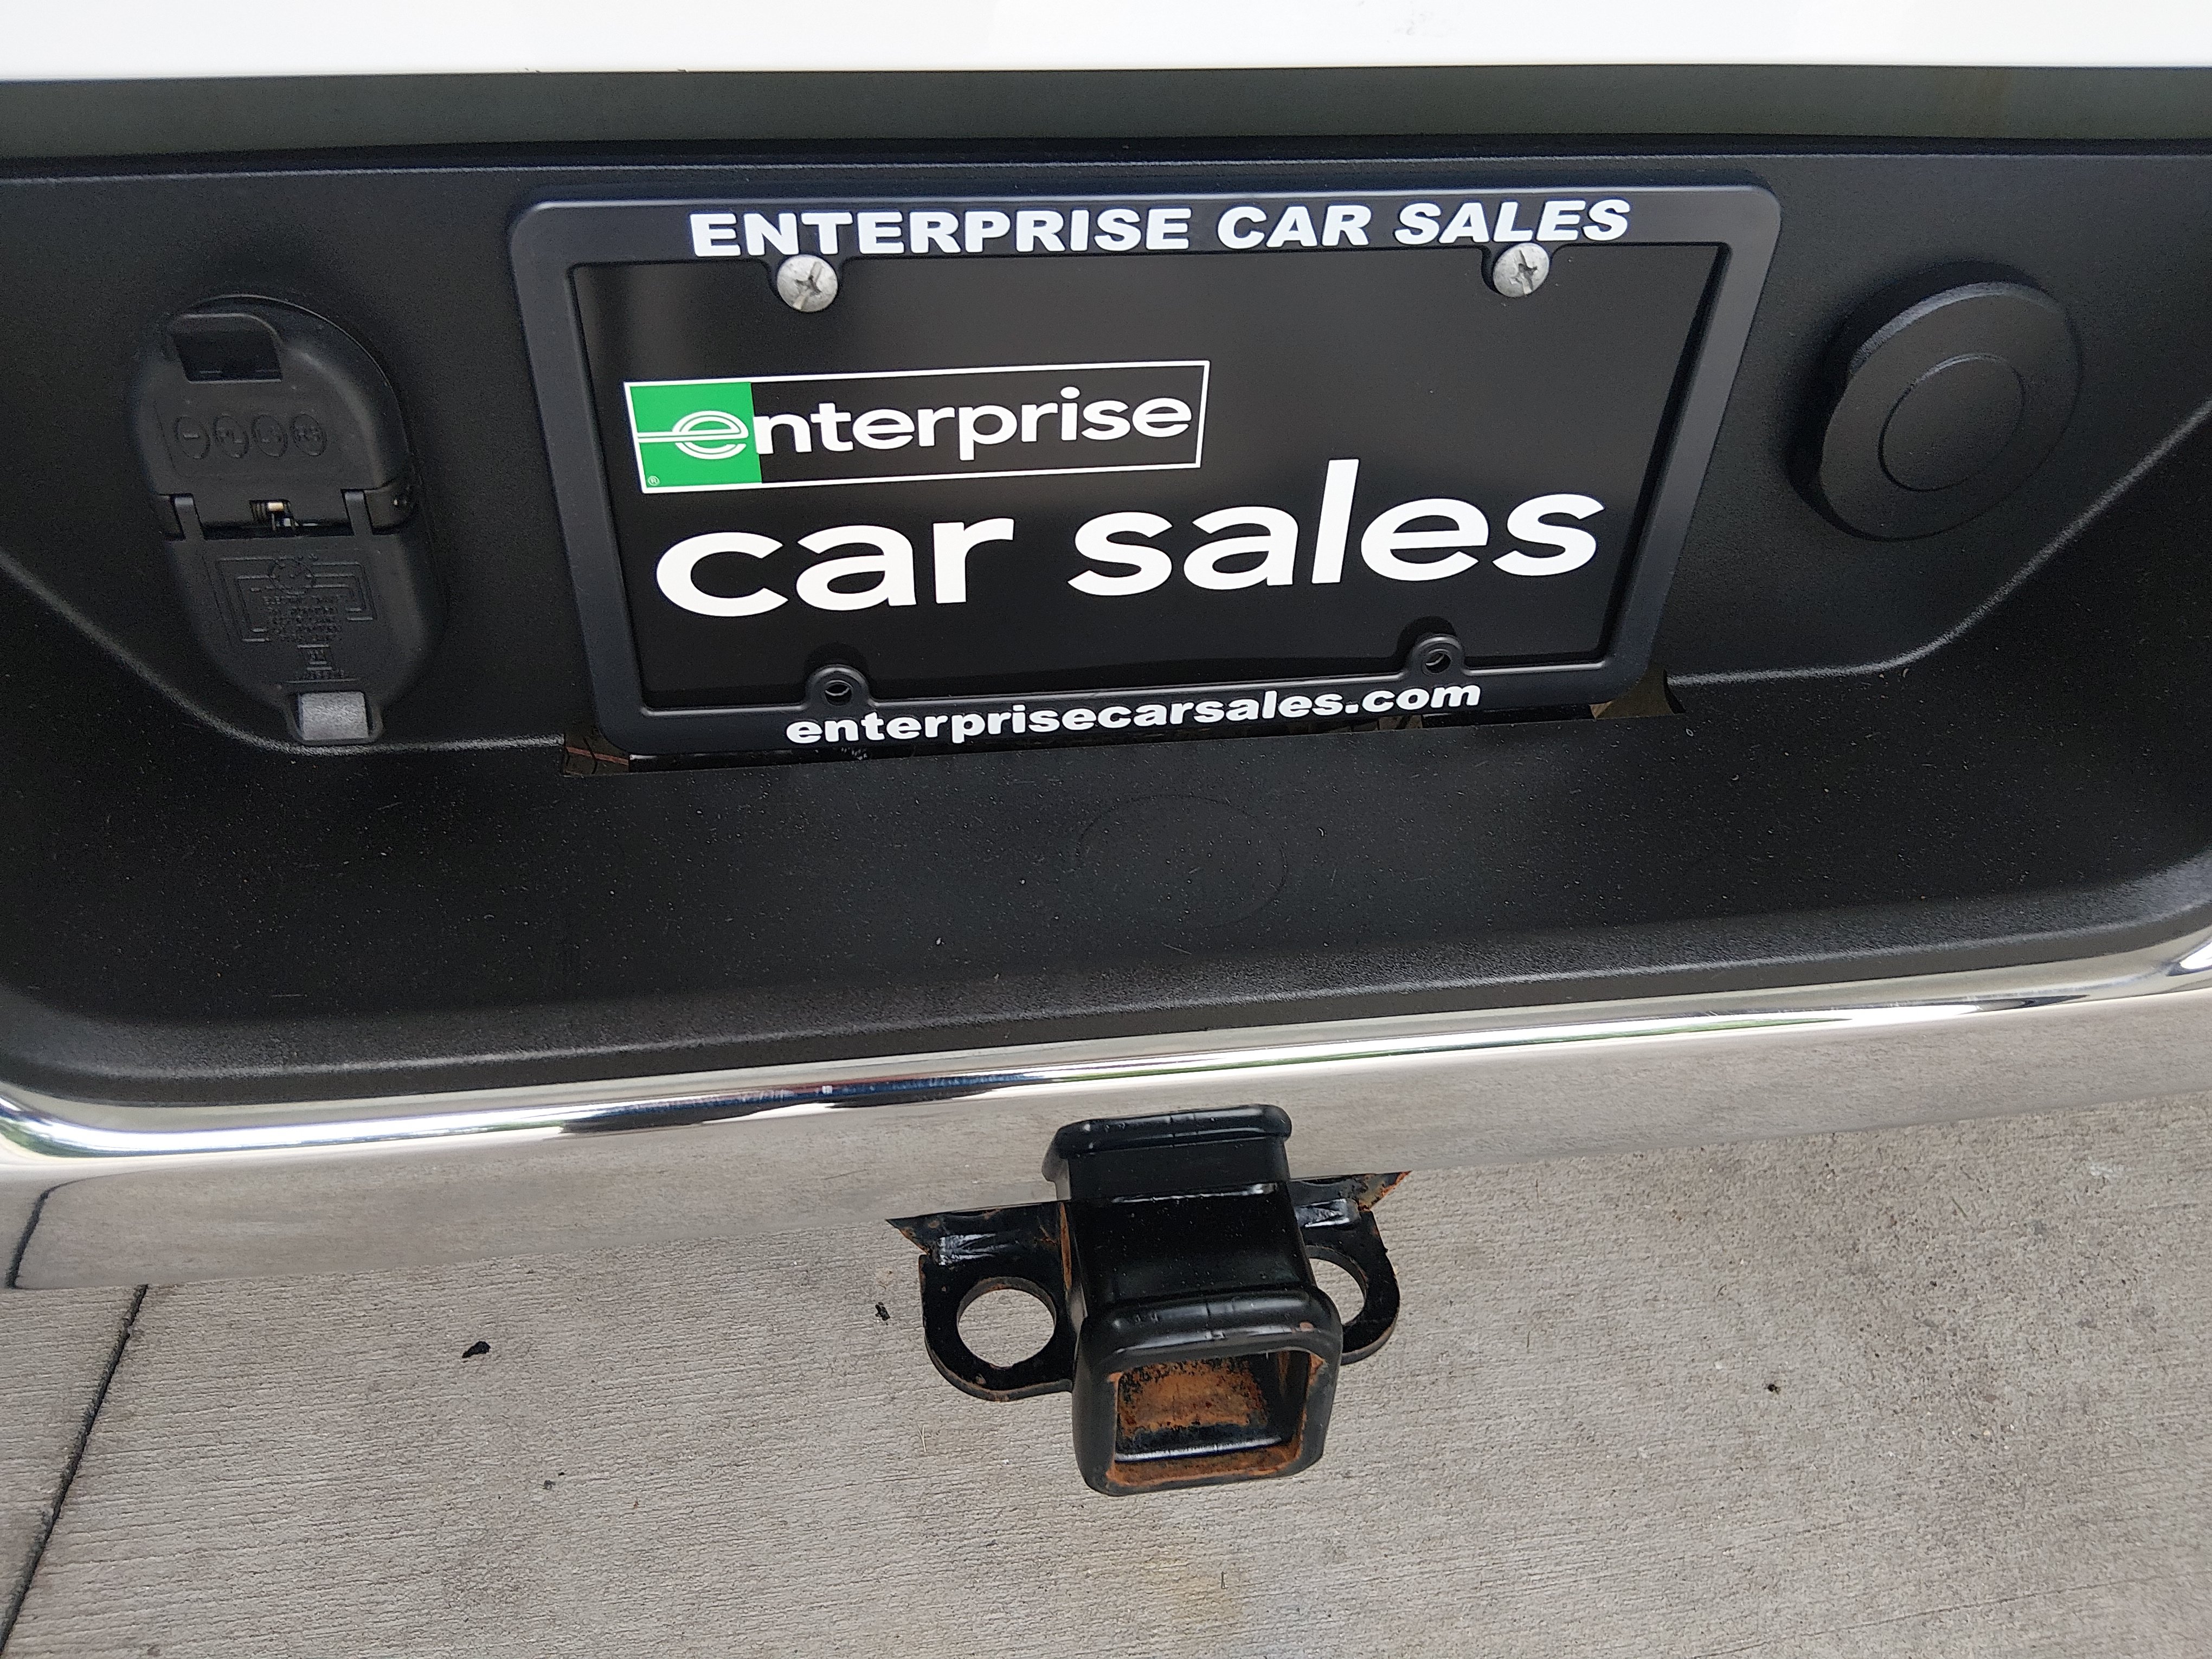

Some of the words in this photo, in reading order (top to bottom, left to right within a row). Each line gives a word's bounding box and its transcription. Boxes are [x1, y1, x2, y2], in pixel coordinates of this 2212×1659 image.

[690, 208, 1192, 257] ENTERPRISE
[1217, 205, 1372, 249] CAR
[1394, 199, 1631, 245] SALES
[671, 387, 1192, 461] enterprise
[656, 518, 1014, 617] car
[1068, 459, 1604, 596] sales
[786, 685, 1481, 744] enterprisecarsales.com
